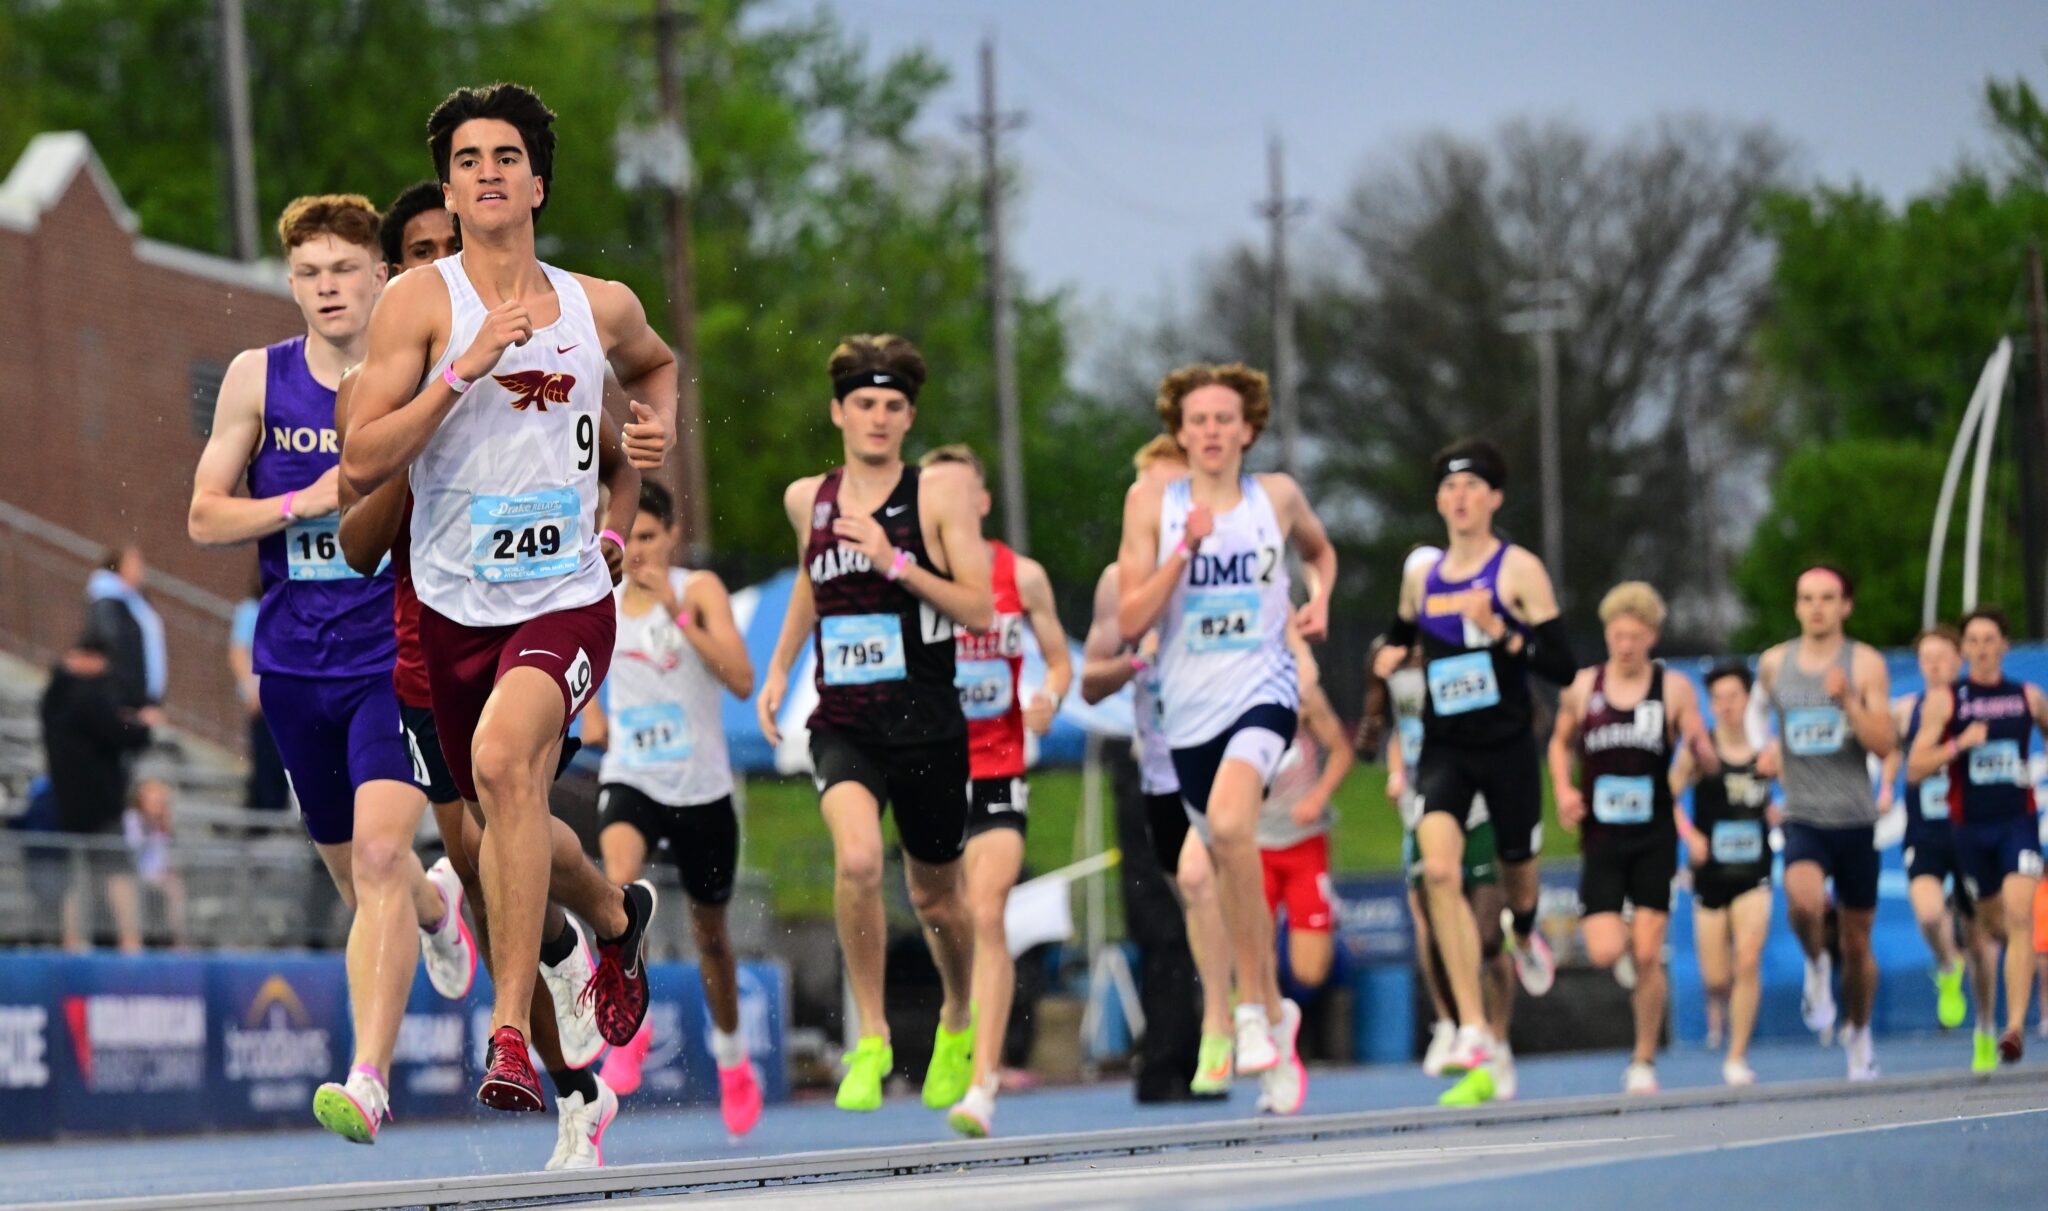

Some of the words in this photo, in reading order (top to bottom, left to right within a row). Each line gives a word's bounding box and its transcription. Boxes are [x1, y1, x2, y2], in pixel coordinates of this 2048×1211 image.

[576, 414, 594, 471] 9
[497, 501, 532, 515] Drake
[532, 499, 562, 512] RELAYS
[297, 531, 336, 560] 16
[493, 524, 561, 559] 249
[1261, 547, 1278, 584] 2
[1200, 616, 1246, 636] 824
[838, 643, 885, 666] 795
[571, 660, 590, 698] 9
